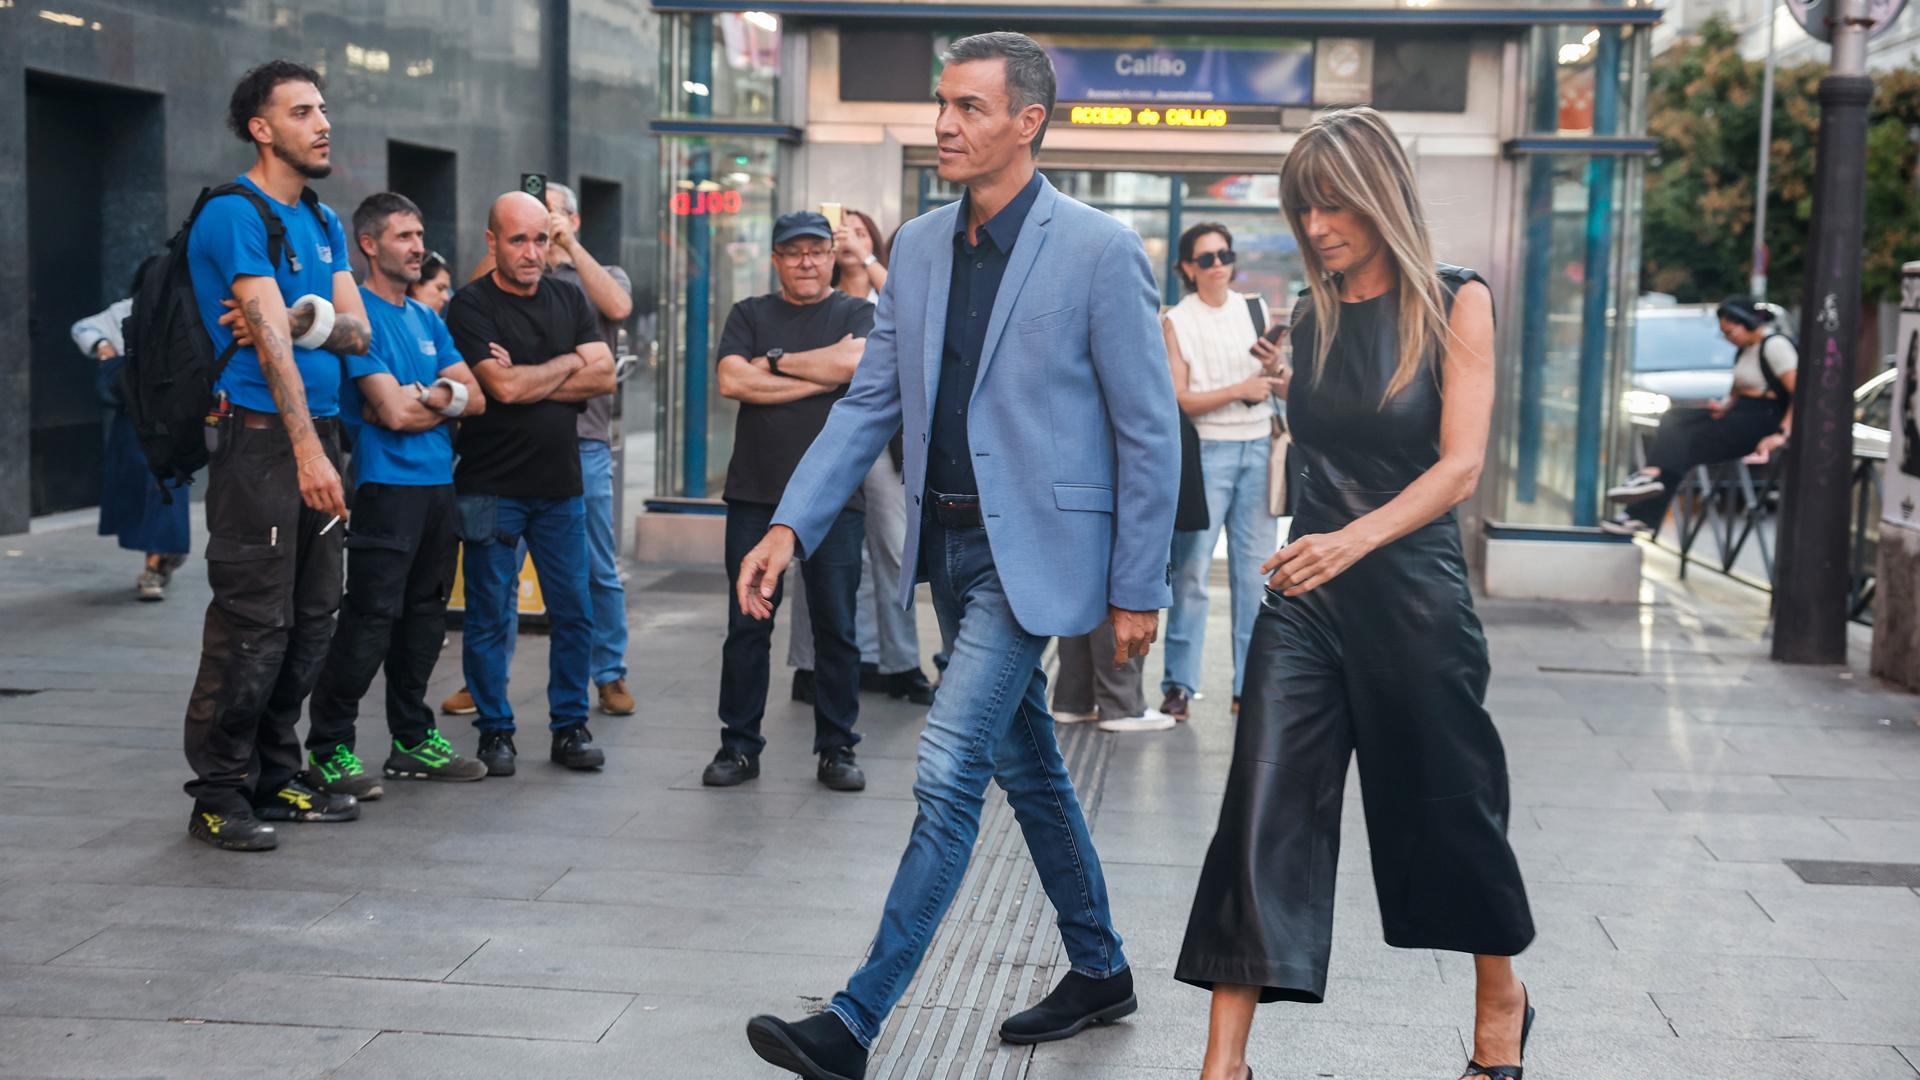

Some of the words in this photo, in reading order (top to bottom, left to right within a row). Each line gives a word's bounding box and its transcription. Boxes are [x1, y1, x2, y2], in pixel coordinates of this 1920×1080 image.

[1115, 54, 1186, 76] Callao
[1071, 106, 1132, 125] ACCESO
[1165, 108, 1227, 126] CALLAO
